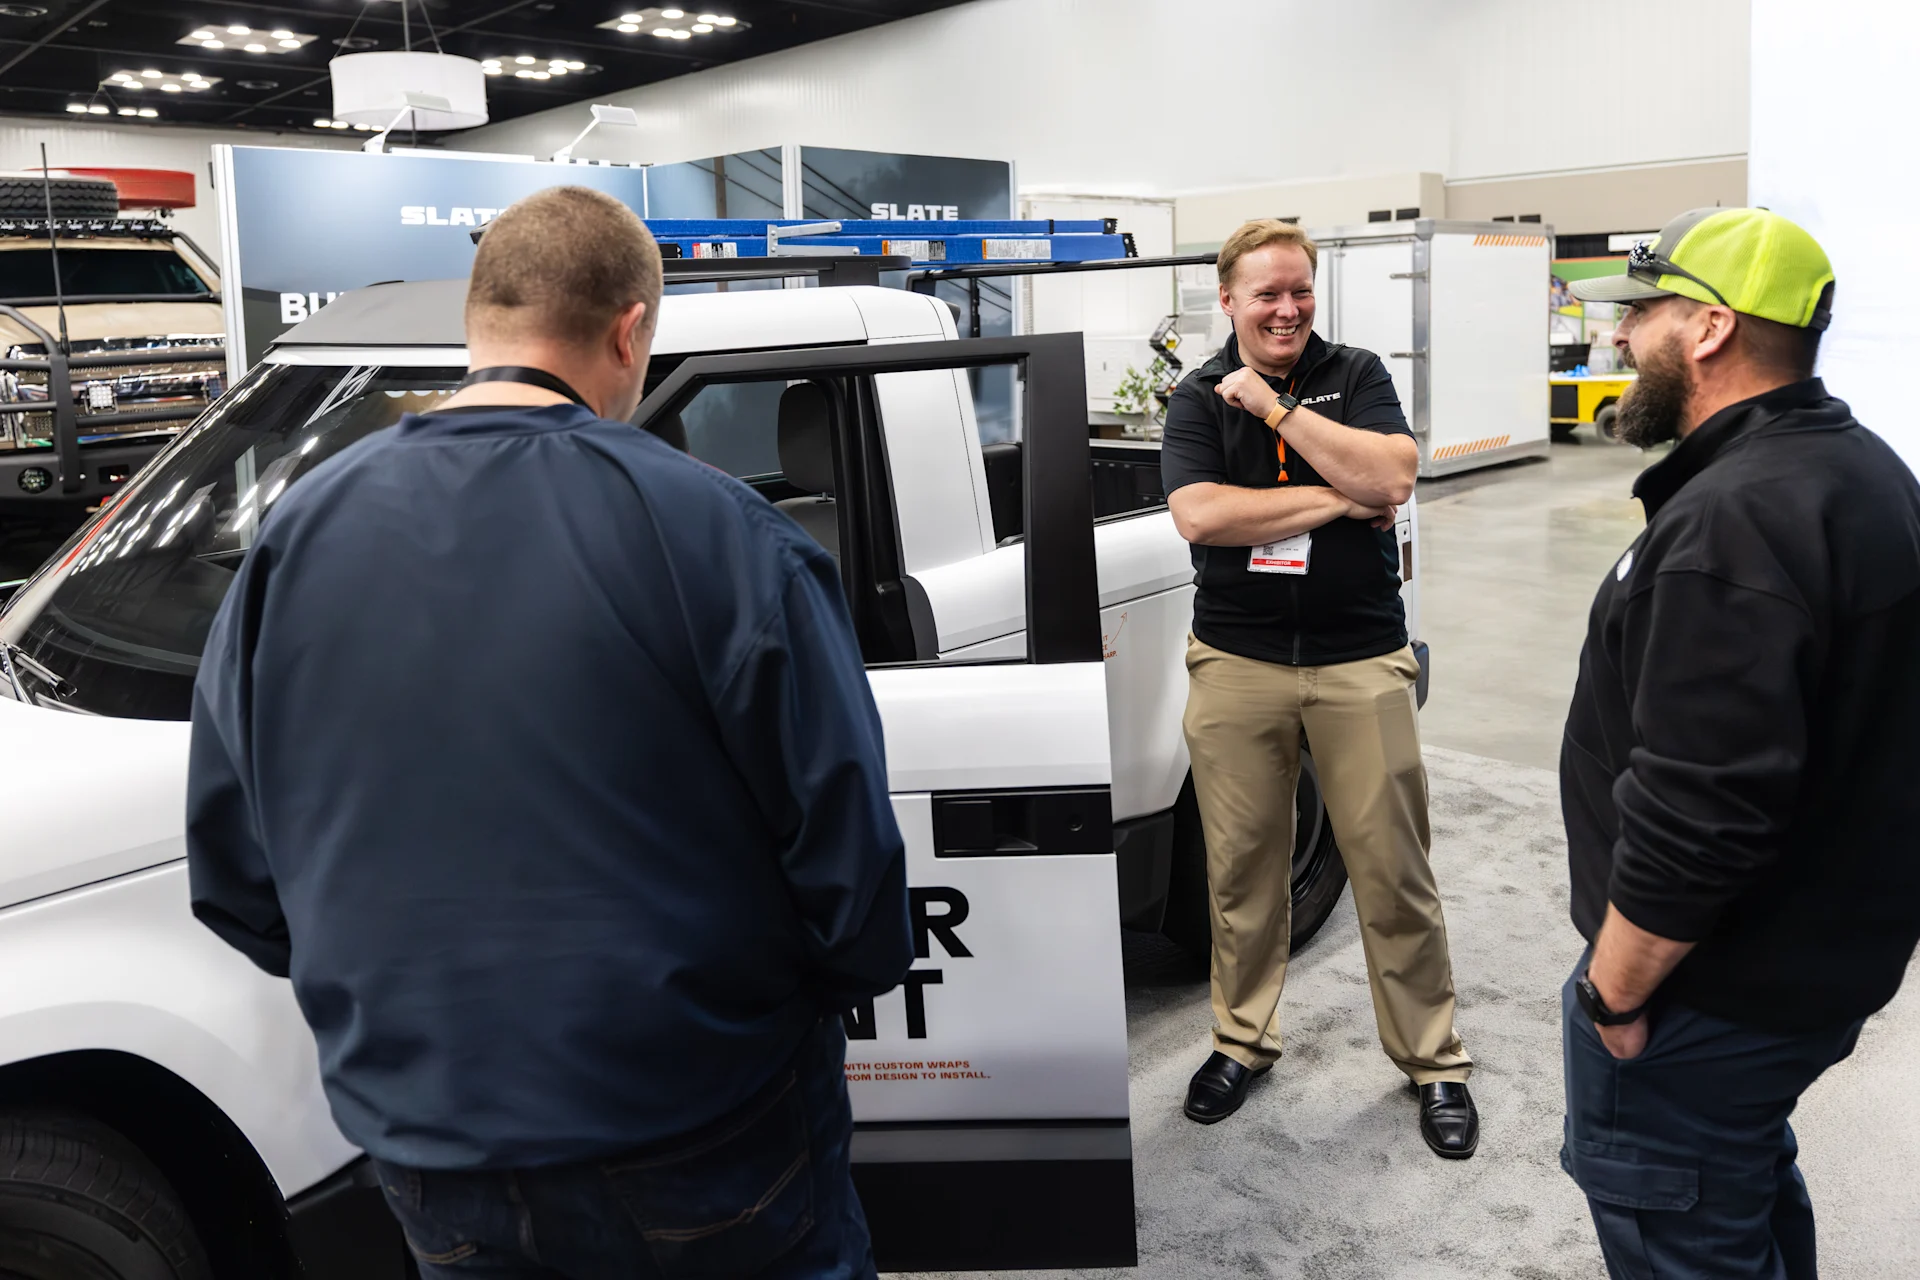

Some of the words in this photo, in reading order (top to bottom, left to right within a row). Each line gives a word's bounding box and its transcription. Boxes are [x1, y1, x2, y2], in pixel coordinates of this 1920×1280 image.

[400, 206, 508, 226] SLAT
[871, 203, 958, 221] SLATE
[1301, 392, 1341, 406] SLATE
[907, 886, 974, 958] R
[874, 1061, 924, 1070] CUSTOM
[927, 1060, 970, 1069] WRAPS
[845, 1073, 871, 1081] ROM
[874, 1072, 918, 1080] DESIGN
[921, 1072, 936, 1080] TO
[940, 1071, 992, 1080] INSTALL.
